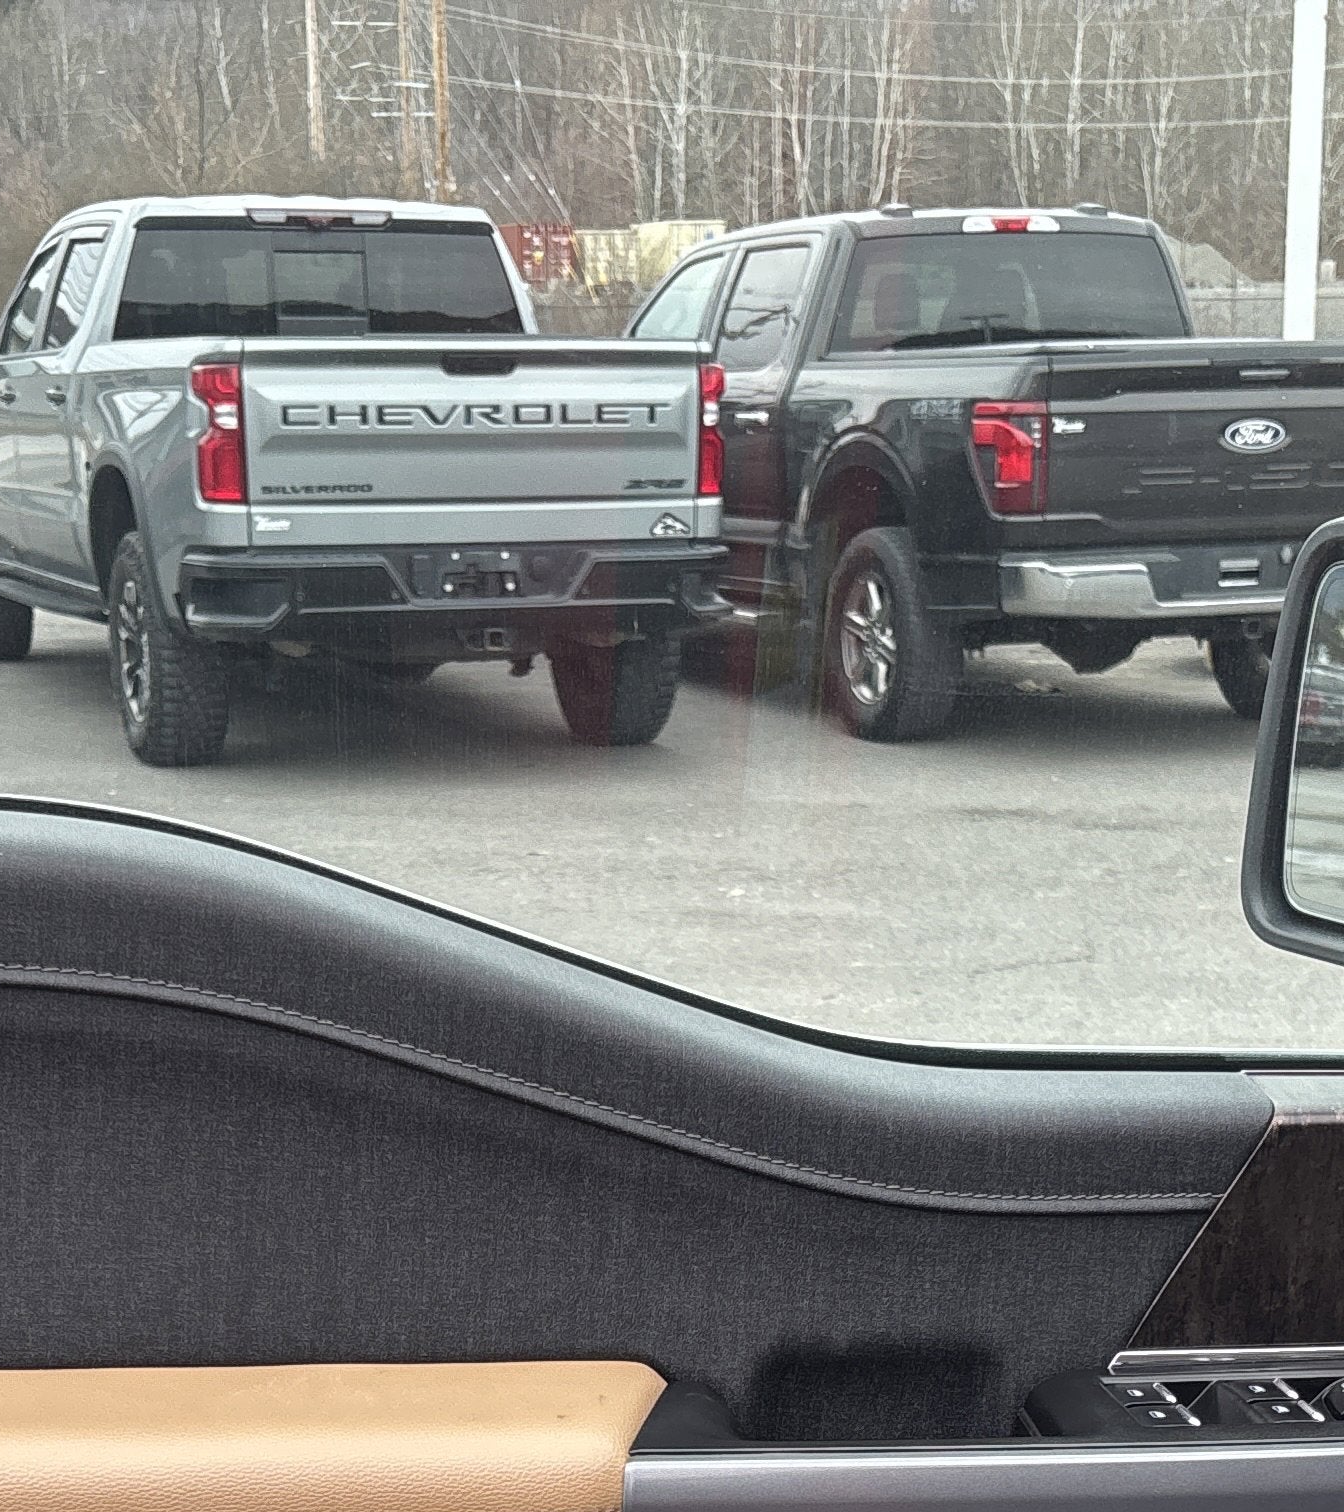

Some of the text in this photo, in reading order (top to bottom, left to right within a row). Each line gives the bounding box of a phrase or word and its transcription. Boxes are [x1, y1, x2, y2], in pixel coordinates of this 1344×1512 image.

[280, 402, 672, 429] CHEVROLET
[1234, 423, 1277, 446] Ford
[261, 484, 373, 495] SILVERADO
